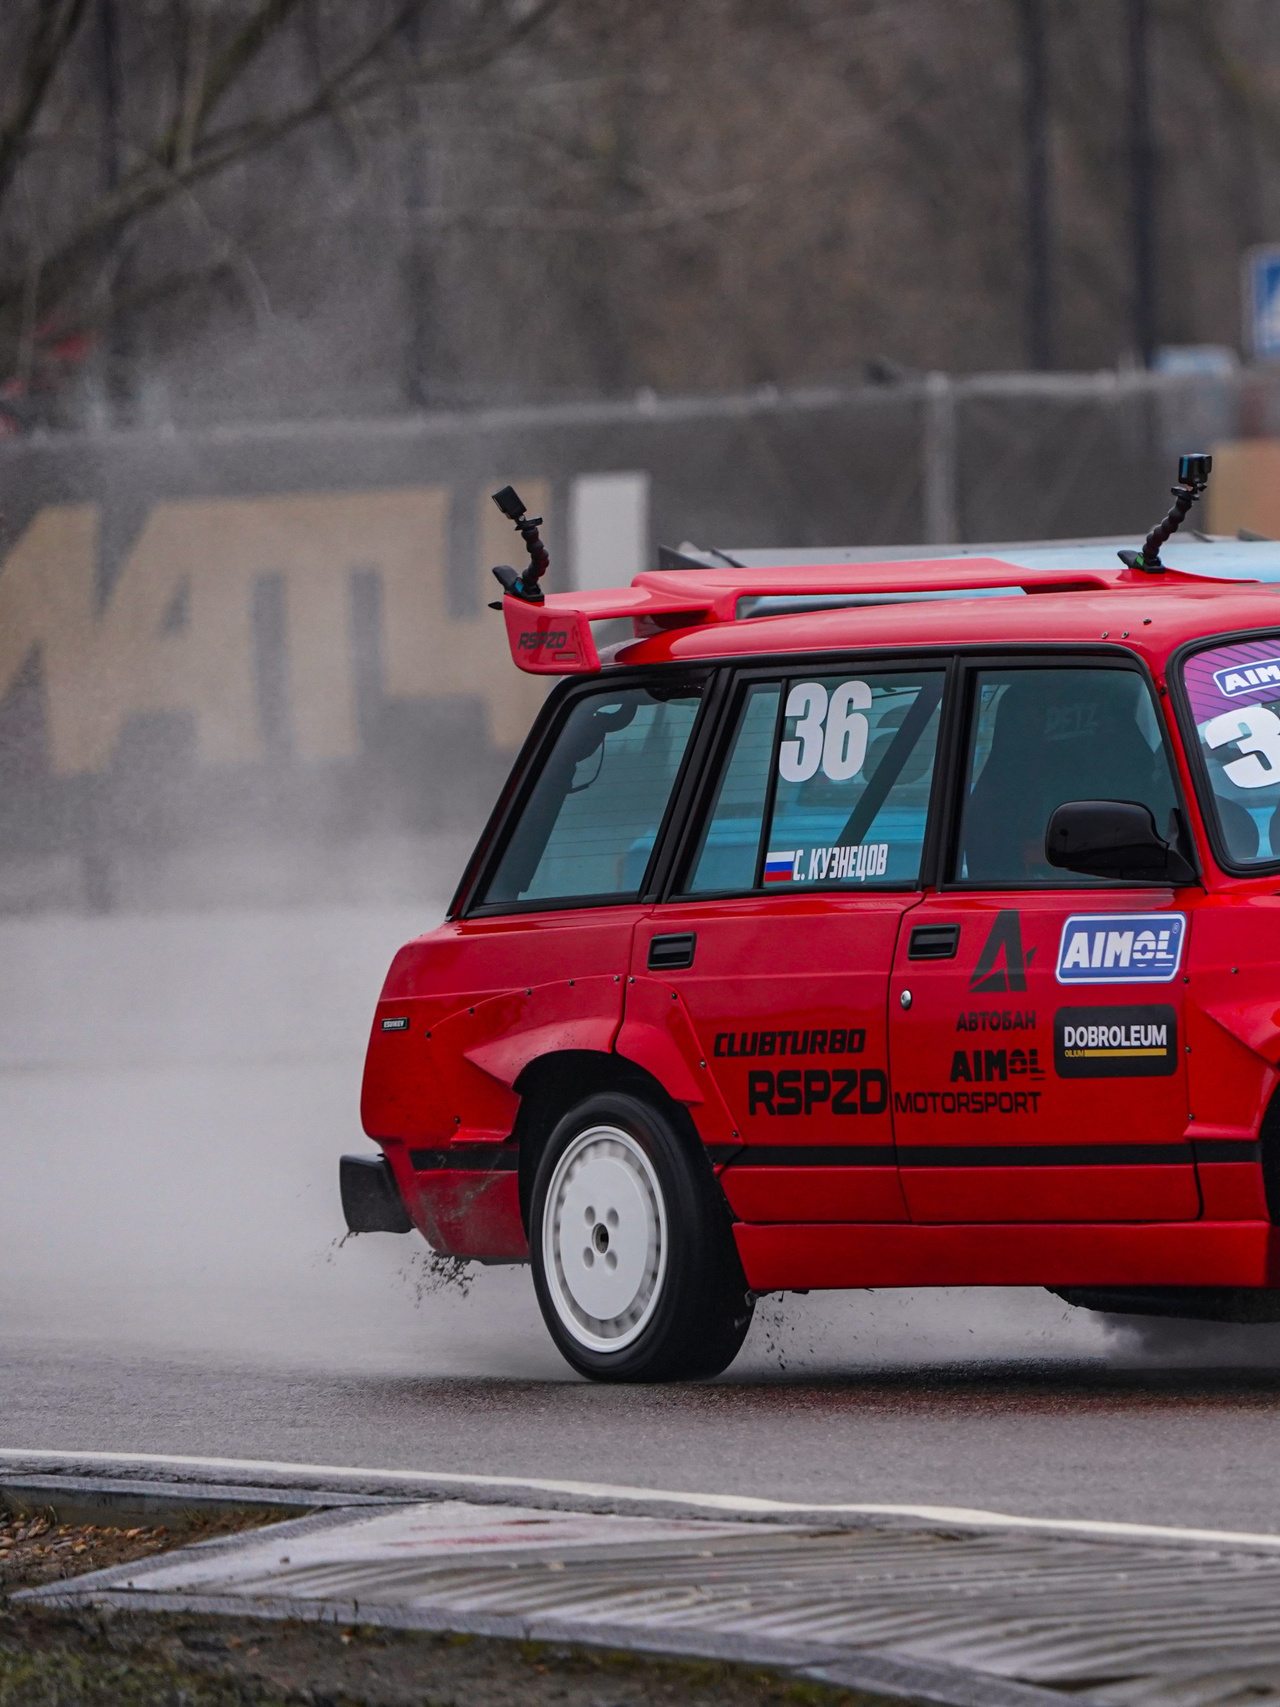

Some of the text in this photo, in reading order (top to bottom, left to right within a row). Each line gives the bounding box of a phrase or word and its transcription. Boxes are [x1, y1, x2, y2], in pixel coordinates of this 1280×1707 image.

[518, 631, 567, 650] RSPZD
[779, 680, 872, 783] 36
[807, 843, 889, 882] КУЗНЕЦОВ
[1062, 930, 1175, 969] AIMOL
[956, 1010, 1037, 1032] АВТОБАН
[1064, 1024, 1168, 1047] DOBROLEUM
[713, 1028, 866, 1058] CLUBTURBO
[949, 1048, 1046, 1082] AIMOL
[747, 1068, 1043, 1116] RSPZD MOTORSPORT
